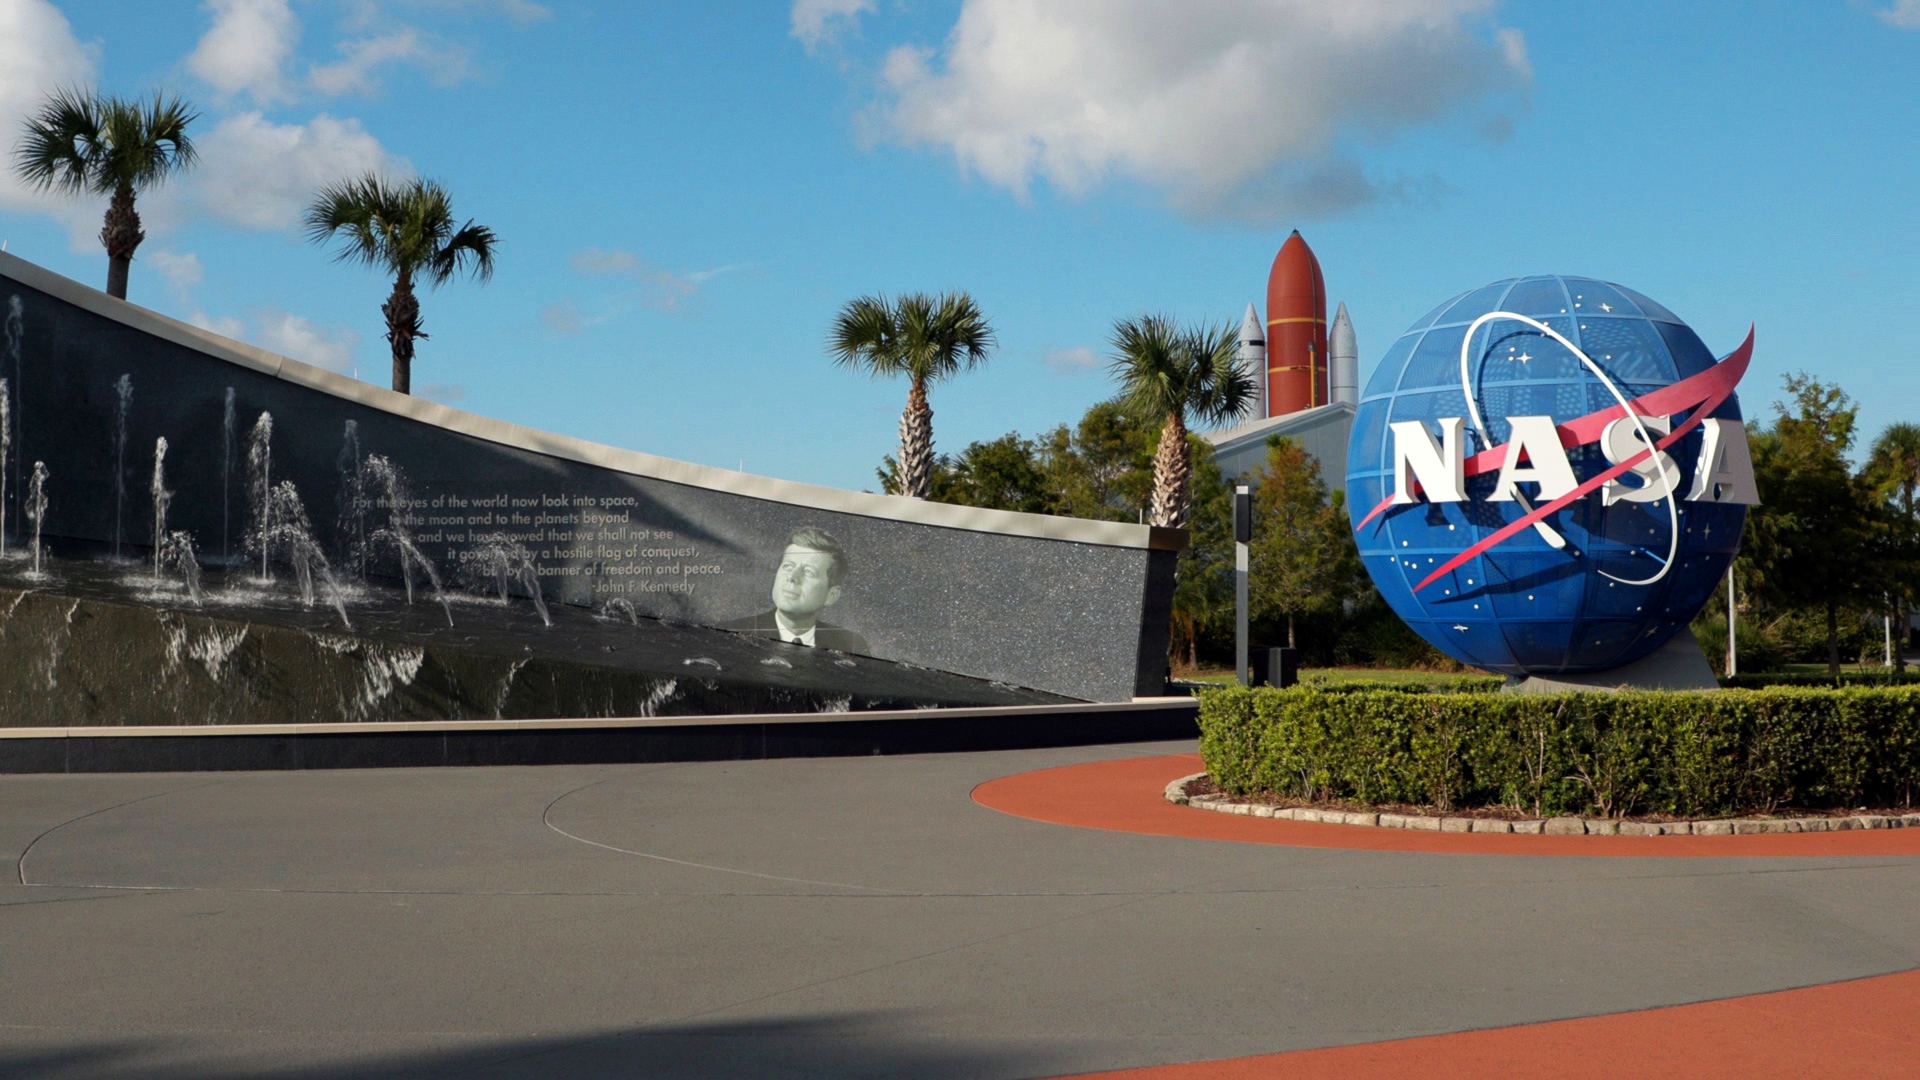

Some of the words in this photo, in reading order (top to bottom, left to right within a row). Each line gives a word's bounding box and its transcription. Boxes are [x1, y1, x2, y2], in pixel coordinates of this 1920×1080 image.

[1388, 414, 1761, 507] NASA
[352, 496, 373, 508] For
[376, 495, 396, 508] the
[399, 498, 428, 512] eyes
[431, 494, 445, 508] of
[448, 494, 469, 508] the
[472, 494, 508, 508] world
[512, 497, 539, 508] now
[542, 494, 569, 507] look
[573, 494, 597, 507] into
[600, 496, 639, 510] space,
[404, 512, 425, 526] the
[428, 515, 464, 525] moon
[467, 512, 492, 525] and
[496, 513, 508, 525] to
[511, 511, 532, 525] the
[534, 511, 579, 528] planets
[582, 510, 630, 527] beyond
[418, 529, 442, 543] and
[446, 532, 465, 543] we
[469, 528, 498, 542] have
[503, 528, 544, 542] vowed
[547, 529, 572, 542] that
[576, 531, 594, 541] we
[597, 528, 627, 541] shall
[630, 529, 650, 541] not
[653, 531, 674, 540] see
[447, 547, 457, 560] it
[523, 545, 538, 561] by
[541, 549, 550, 559] a
[554, 545, 593, 559] hostile
[597, 544, 622, 561] flag
[625, 544, 639, 558] of
[641, 546, 700, 560] conquest,
[482, 563, 498, 577] bu
[507, 562, 522, 579] by
[537, 562, 581, 576] banner
[584, 561, 599, 576] of
[601, 561, 652, 575] freedom
[656, 561, 680, 575] and
[684, 565, 724, 577] peace.
[640, 578, 696, 596] Kennedy
